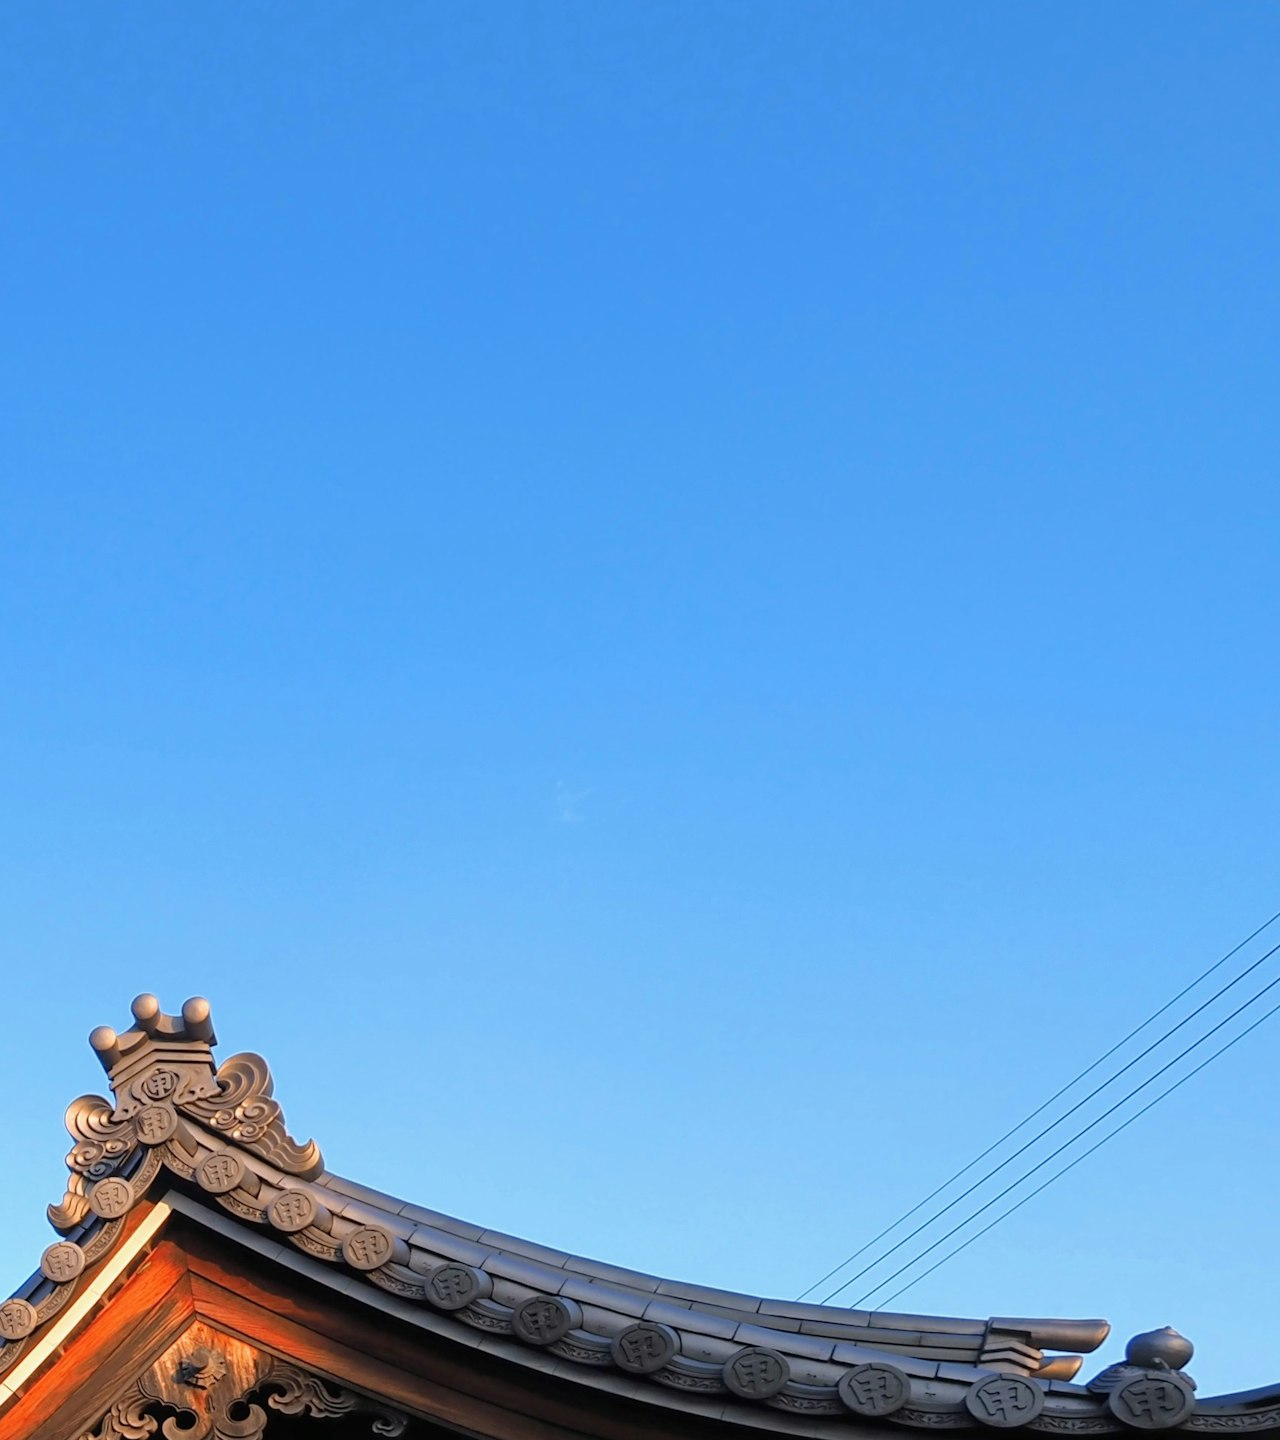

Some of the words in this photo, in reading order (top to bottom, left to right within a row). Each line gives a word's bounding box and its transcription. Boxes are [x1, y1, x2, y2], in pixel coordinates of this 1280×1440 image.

[142, 1110, 168, 1139] 甲
[202, 1159, 234, 1188] 甲
[95, 1187, 123, 1213] 甲
[273, 1198, 306, 1226] 甲
[46, 1251, 73, 1277] 甲
[348, 1235, 384, 1264] 甲
[619, 1335, 661, 1367] 甲
[731, 1359, 775, 1394] 甲
[848, 1376, 894, 1410] 甲
[976, 1386, 1027, 1421] 甲
[1119, 1386, 1174, 1423] 甲
